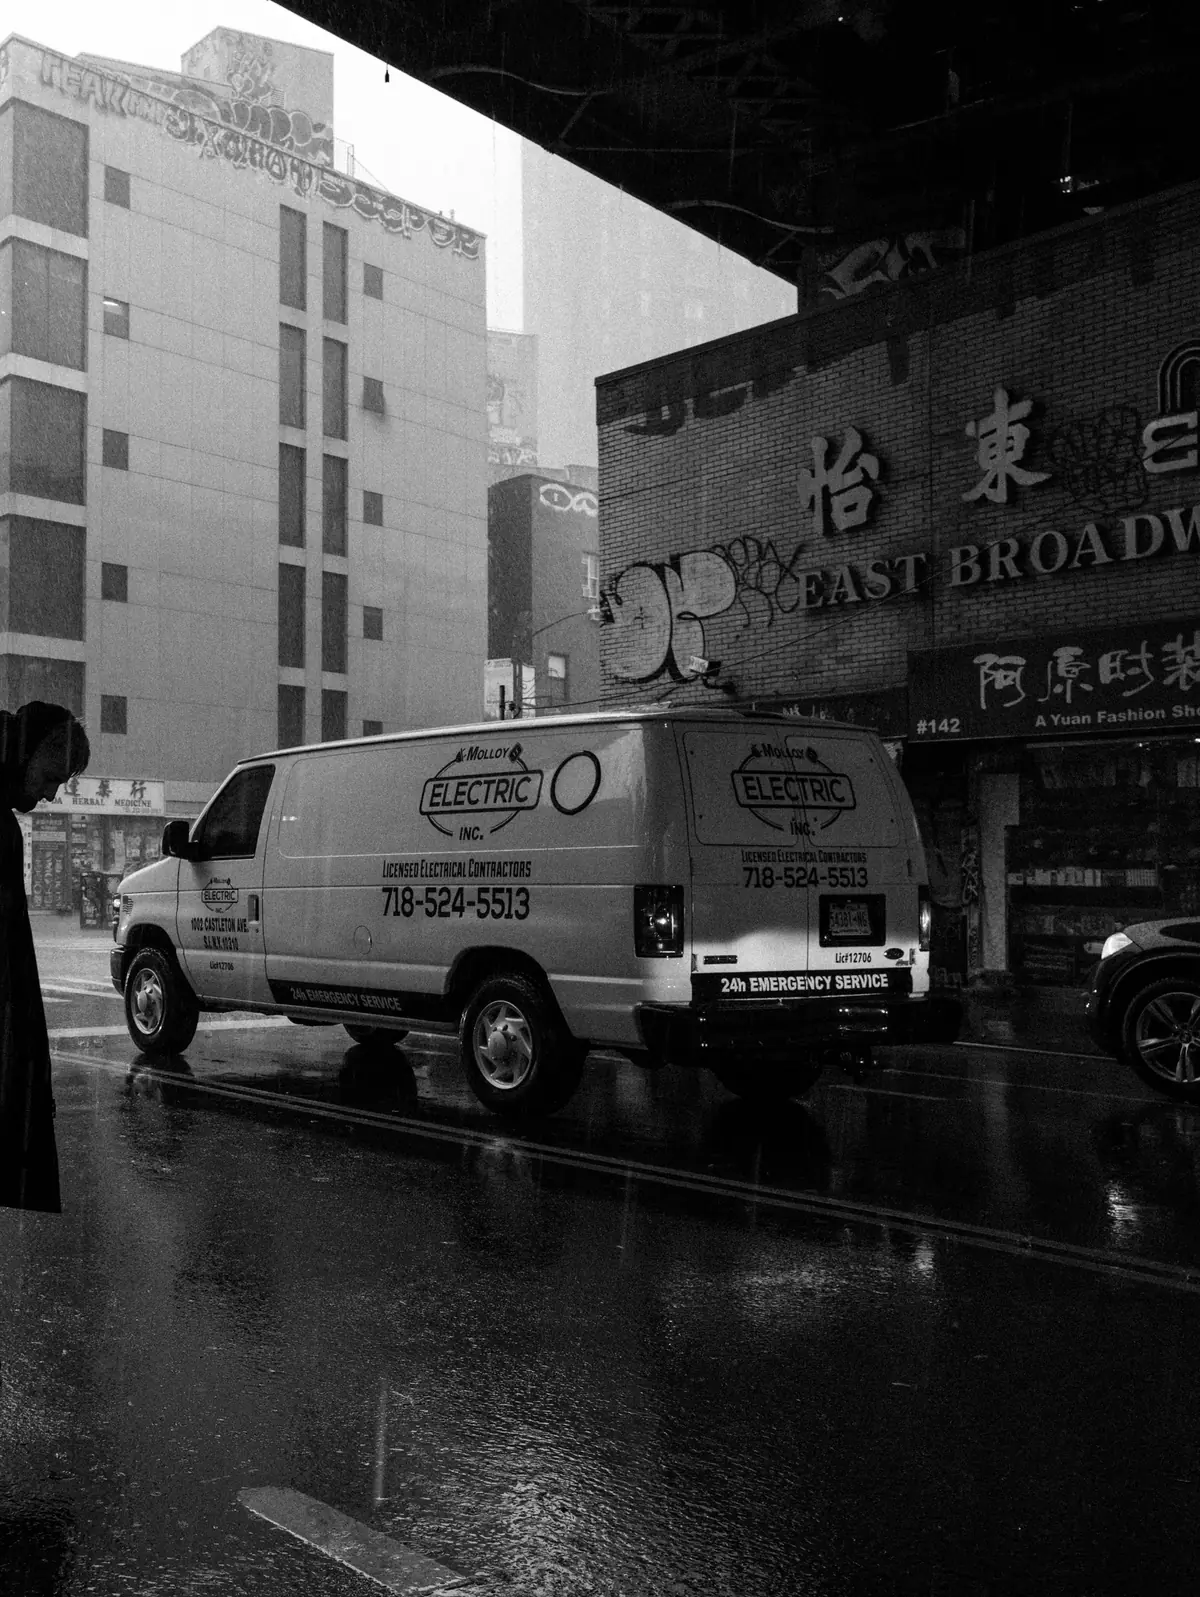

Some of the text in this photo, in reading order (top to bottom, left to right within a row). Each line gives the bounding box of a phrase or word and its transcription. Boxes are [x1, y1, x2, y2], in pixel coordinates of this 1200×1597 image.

[797, 388, 1051, 531] 怡東
[798, 552, 927, 608] EAST
[917, 718, 960, 735] #142
[1035, 715, 1046, 727] A
[1050, 713, 1092, 727] Yuan
[1097, 706, 1166, 724] Fashion
[429, 776, 532, 807] ELECTRIC
[742, 776, 845, 803] ELECTRIC
[72, 798, 105, 806] HERBAL
[114, 799, 152, 808] MEDICINE
[459, 826, 484, 841] INC.
[790, 821, 816, 836] INC.
[741, 849, 868, 863] LICENSED ELECTRICAL CONTRACTORS
[382, 858, 532, 878] LICENSED ELECTRICAL CONTRACTORS
[742, 867, 869, 888] 718-524-5513
[204, 891, 236, 901] ELECTRIC
[382, 886, 530, 920] 718-524-5513
[191, 918, 250, 933] 1002 CASTLETON AVE.
[835, 952, 872, 963] Lic#12706
[721, 973, 889, 993] 24h EMERGENCY SERVICE
[290, 987, 403, 1012] 24h EMERGENCY SERVICE
